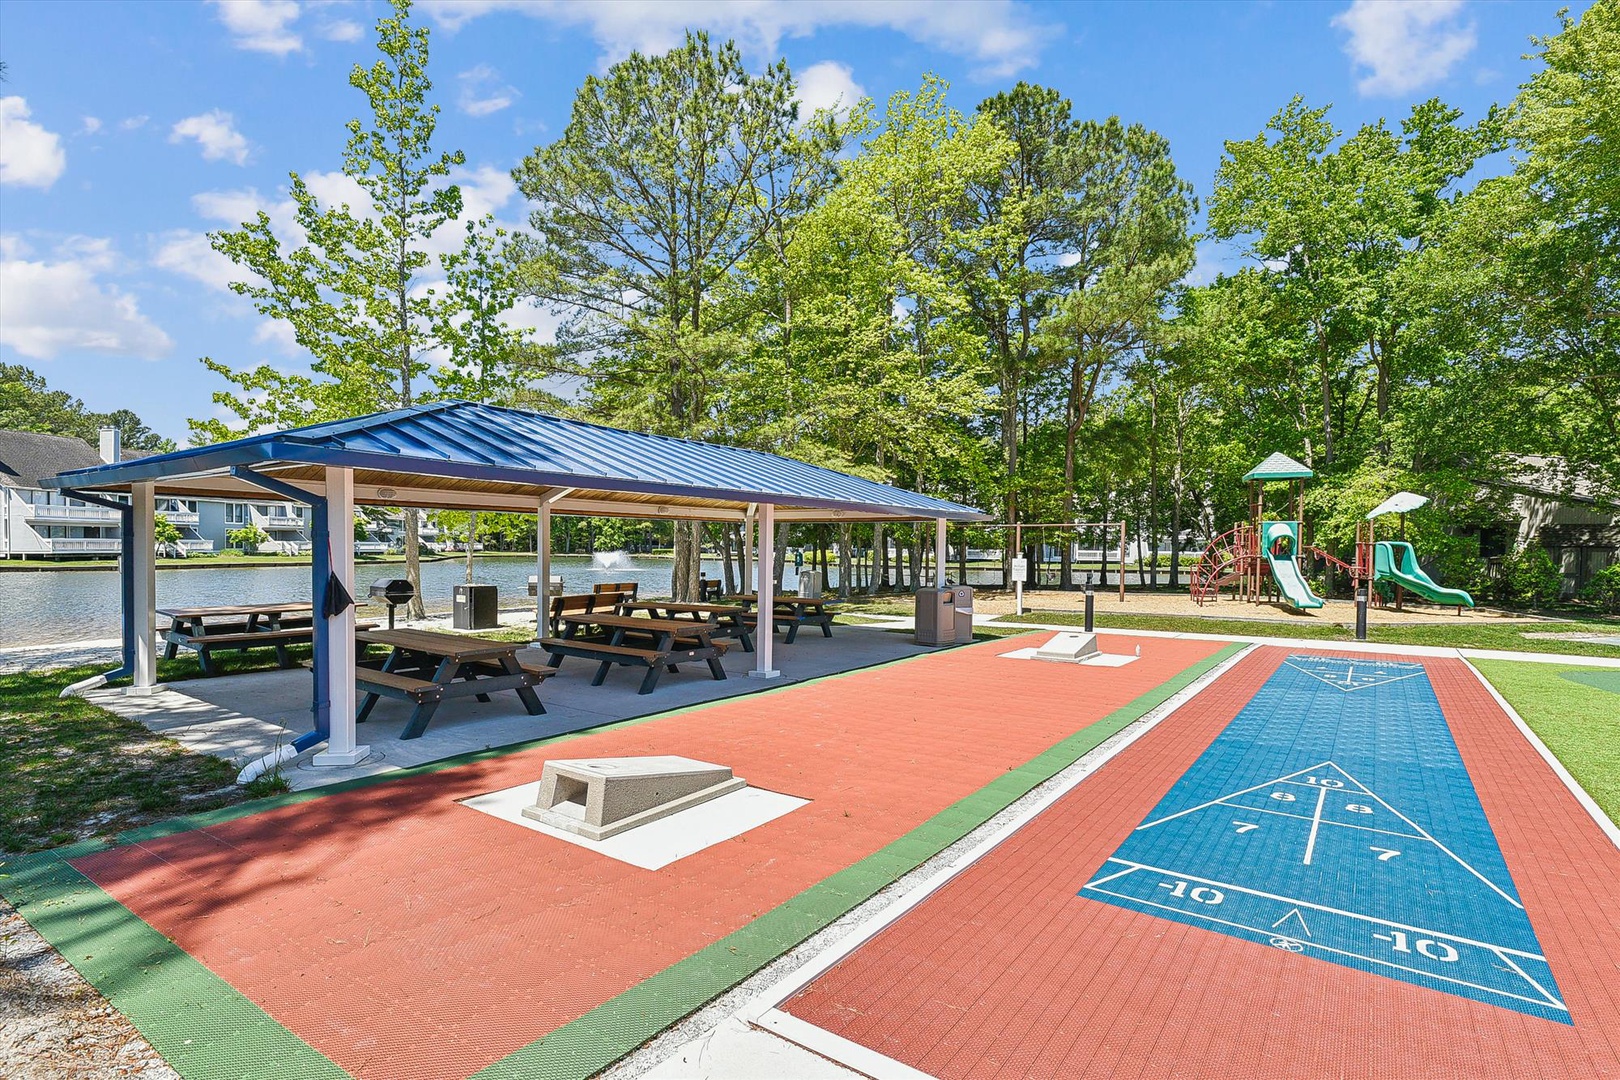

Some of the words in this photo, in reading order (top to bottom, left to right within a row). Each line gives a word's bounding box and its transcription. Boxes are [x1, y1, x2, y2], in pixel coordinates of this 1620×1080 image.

[1307, 776, 1344, 788] 10
[1232, 821, 1259, 834] 7
[1370, 846, 1401, 861] 7
[1158, 881, 1225, 905] -10
[1373, 931, 1459, 962] -10
